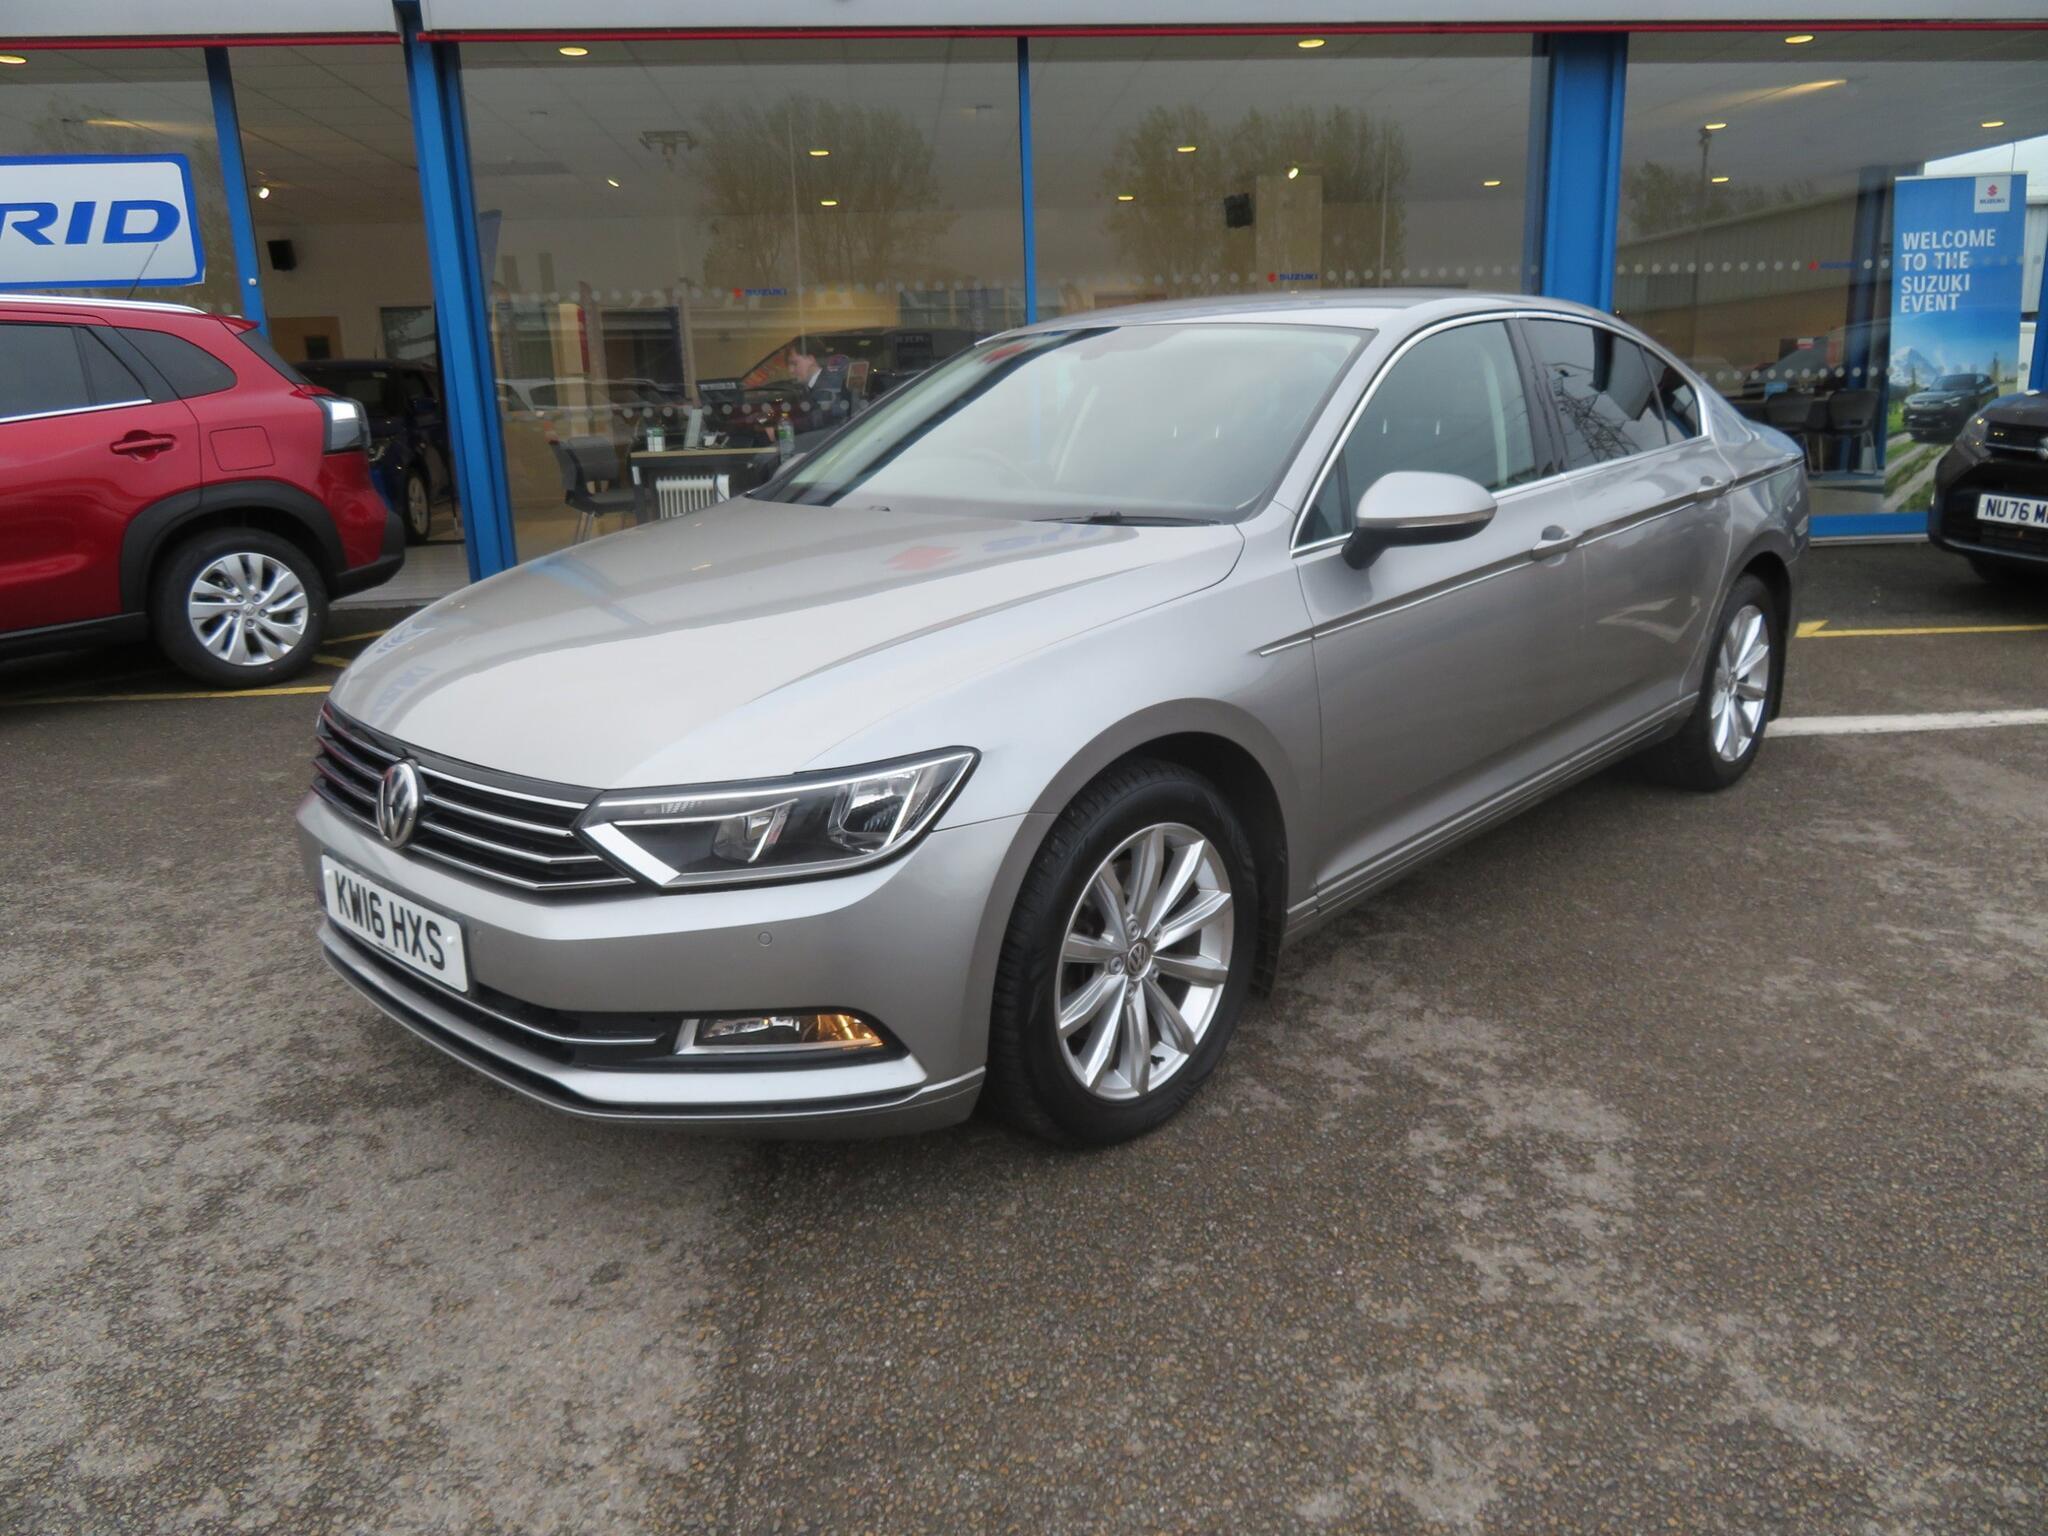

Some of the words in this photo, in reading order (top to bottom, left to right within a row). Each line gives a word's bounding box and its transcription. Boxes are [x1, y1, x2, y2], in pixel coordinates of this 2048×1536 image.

[1902, 228, 1996, 250] WELCOME
[1901, 253, 1927, 272] TO
[1934, 250, 1970, 270] THE
[1901, 273, 1970, 294] SUZUKI
[1900, 293, 1960, 313] EVENT
[1985, 498, 2031, 521] NU76
[2033, 504, 2048, 524] M
[389, 901, 445, 971] HXS
